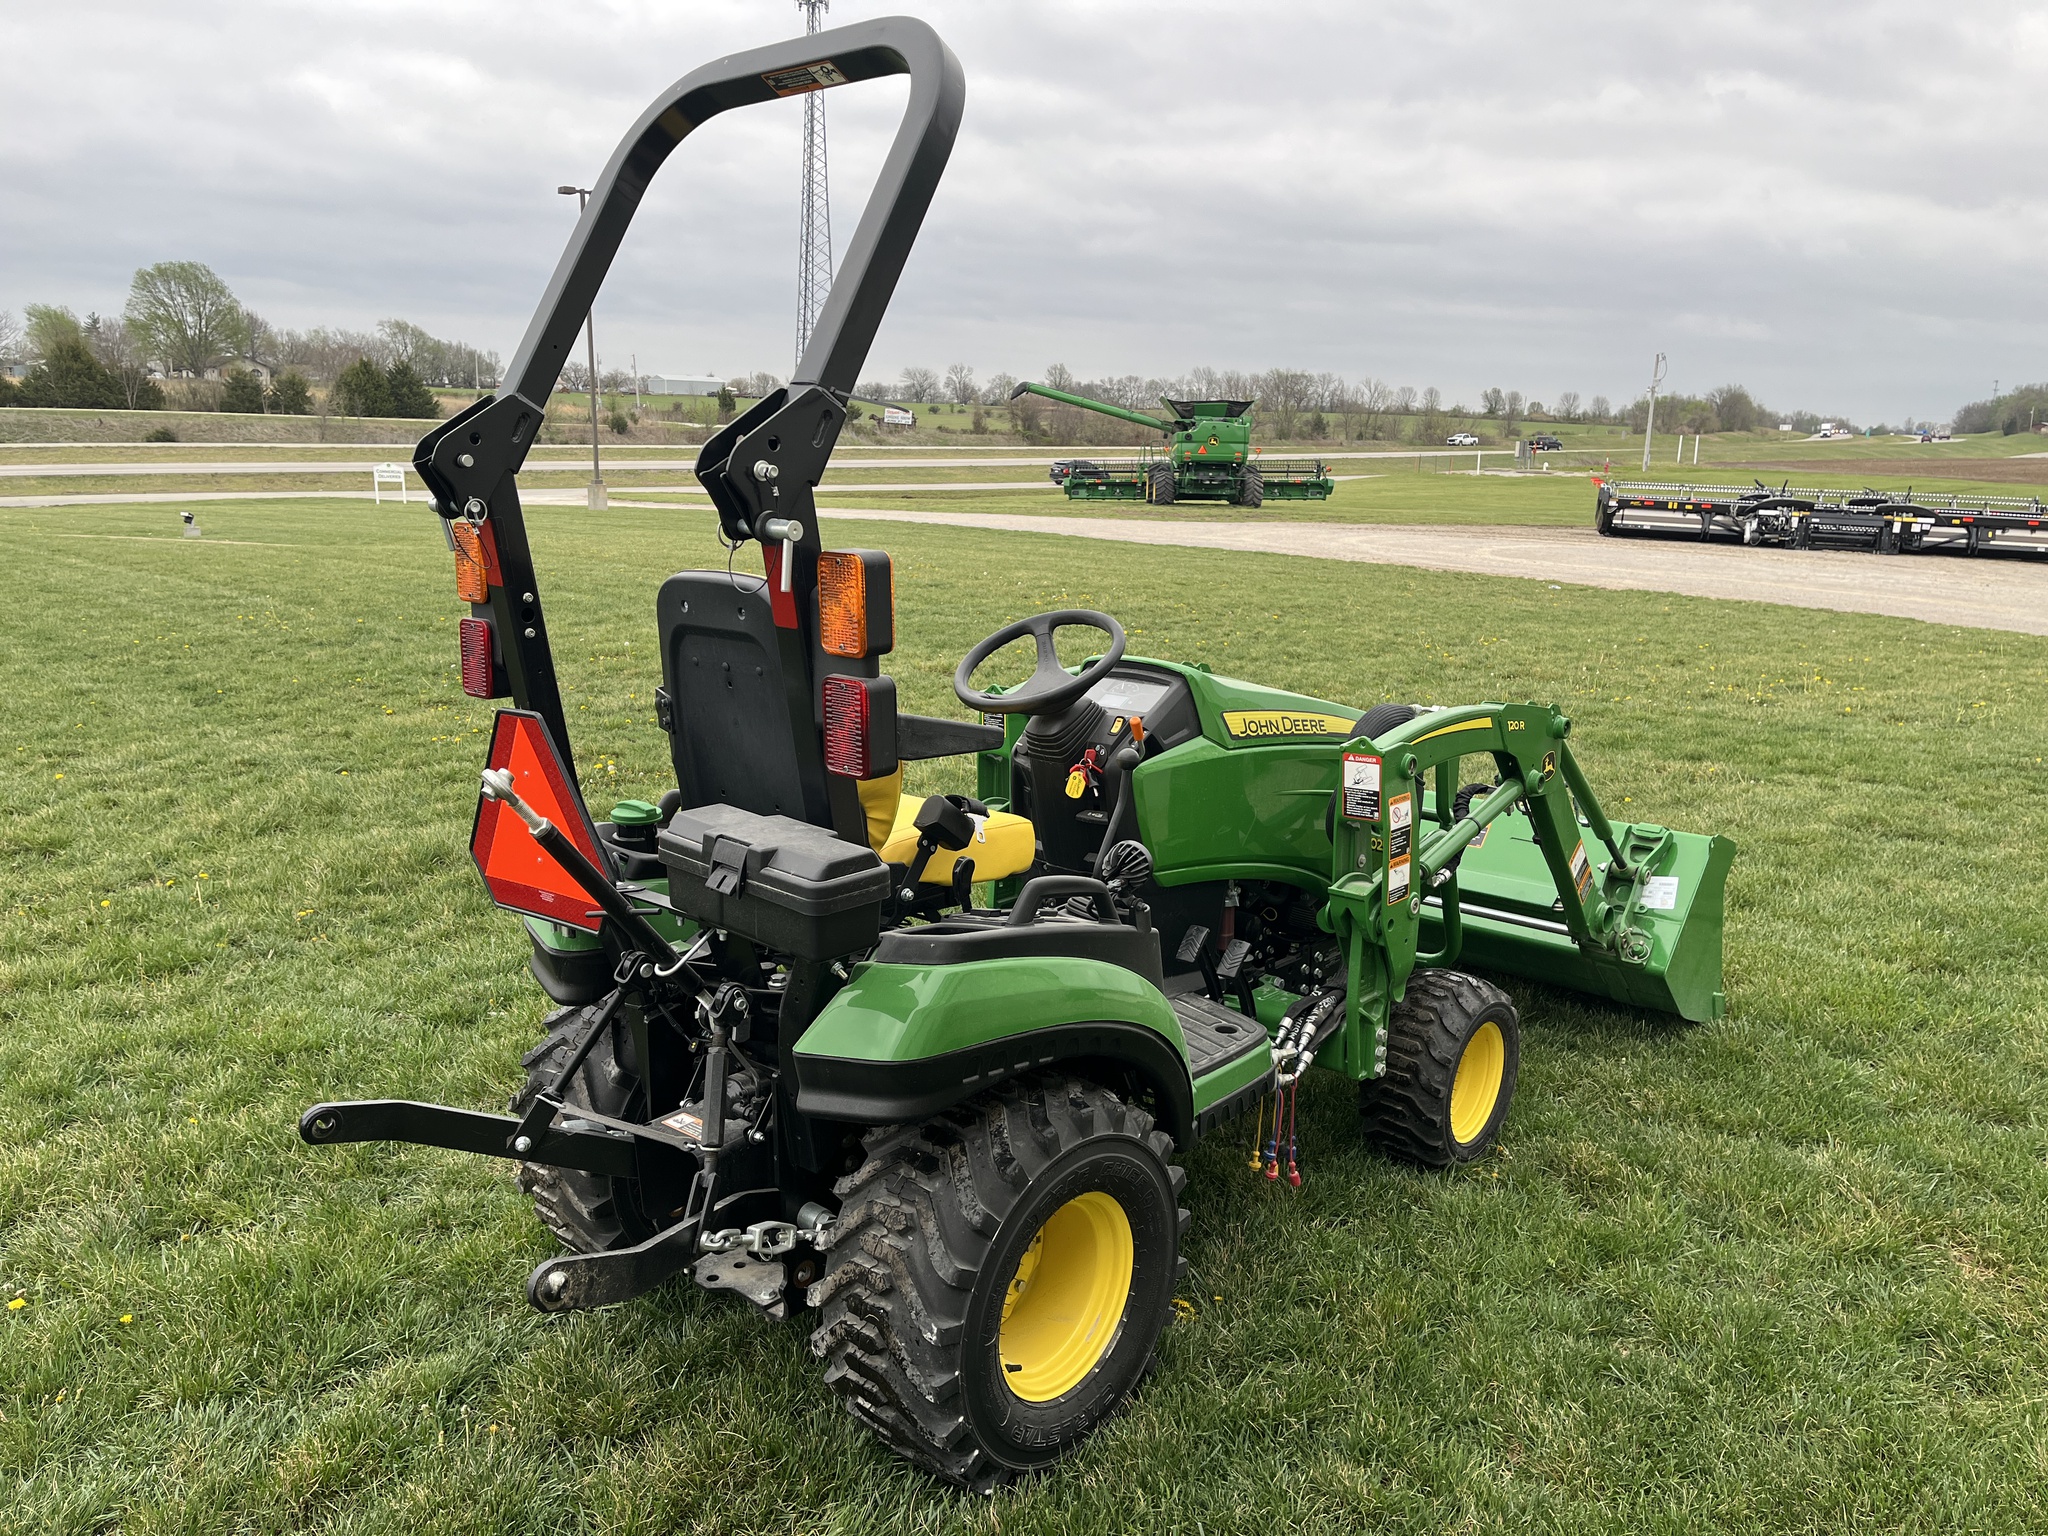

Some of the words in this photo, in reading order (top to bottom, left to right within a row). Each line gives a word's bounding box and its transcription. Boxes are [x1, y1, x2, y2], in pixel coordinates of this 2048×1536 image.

[1240, 718, 1280, 735] JOHN
[1281, 716, 1327, 732] DEERE
[1100, 1160, 1149, 1188] CHIEF
